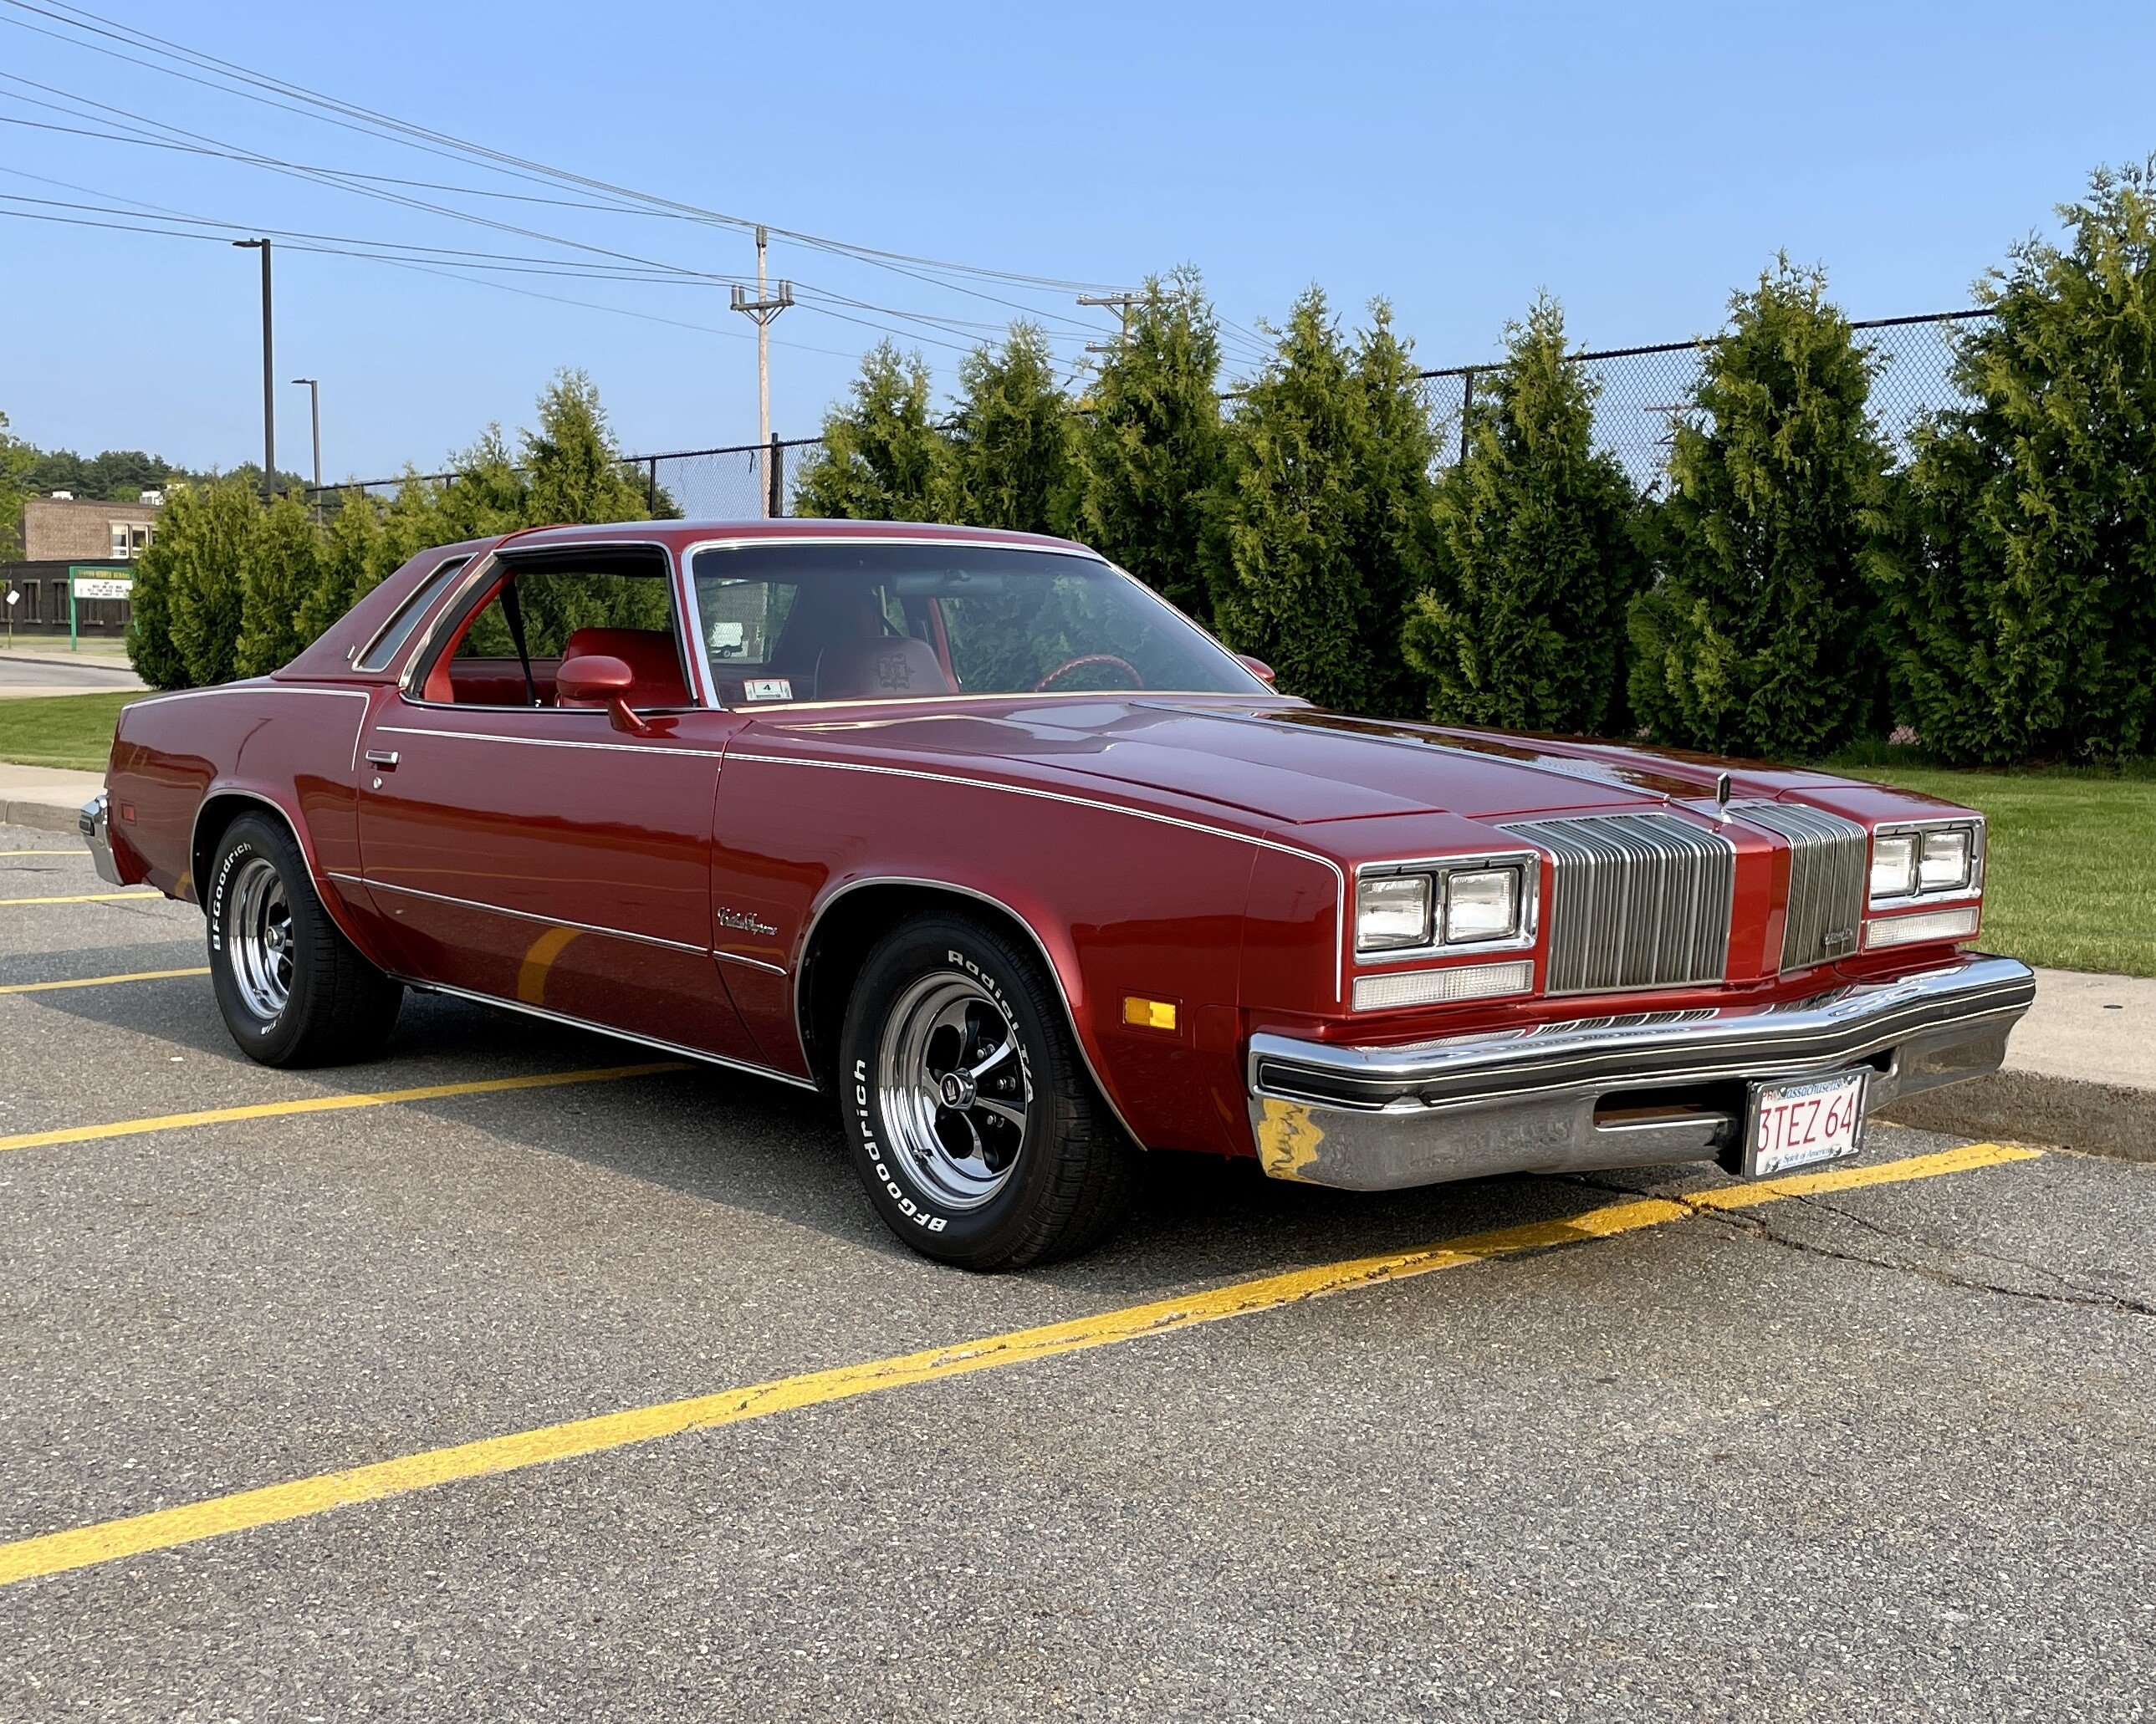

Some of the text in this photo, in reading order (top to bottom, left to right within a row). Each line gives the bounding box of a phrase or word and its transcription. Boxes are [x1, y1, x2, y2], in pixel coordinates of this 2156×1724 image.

[212, 842, 252, 951] BFGoodrich
[948, 950, 1034, 1104] Radial T/A
[1784, 1079, 1842, 1099] assachusetts
[1825, 1092, 1854, 1137] 64
[854, 1059, 948, 1232] BFGoodrich
